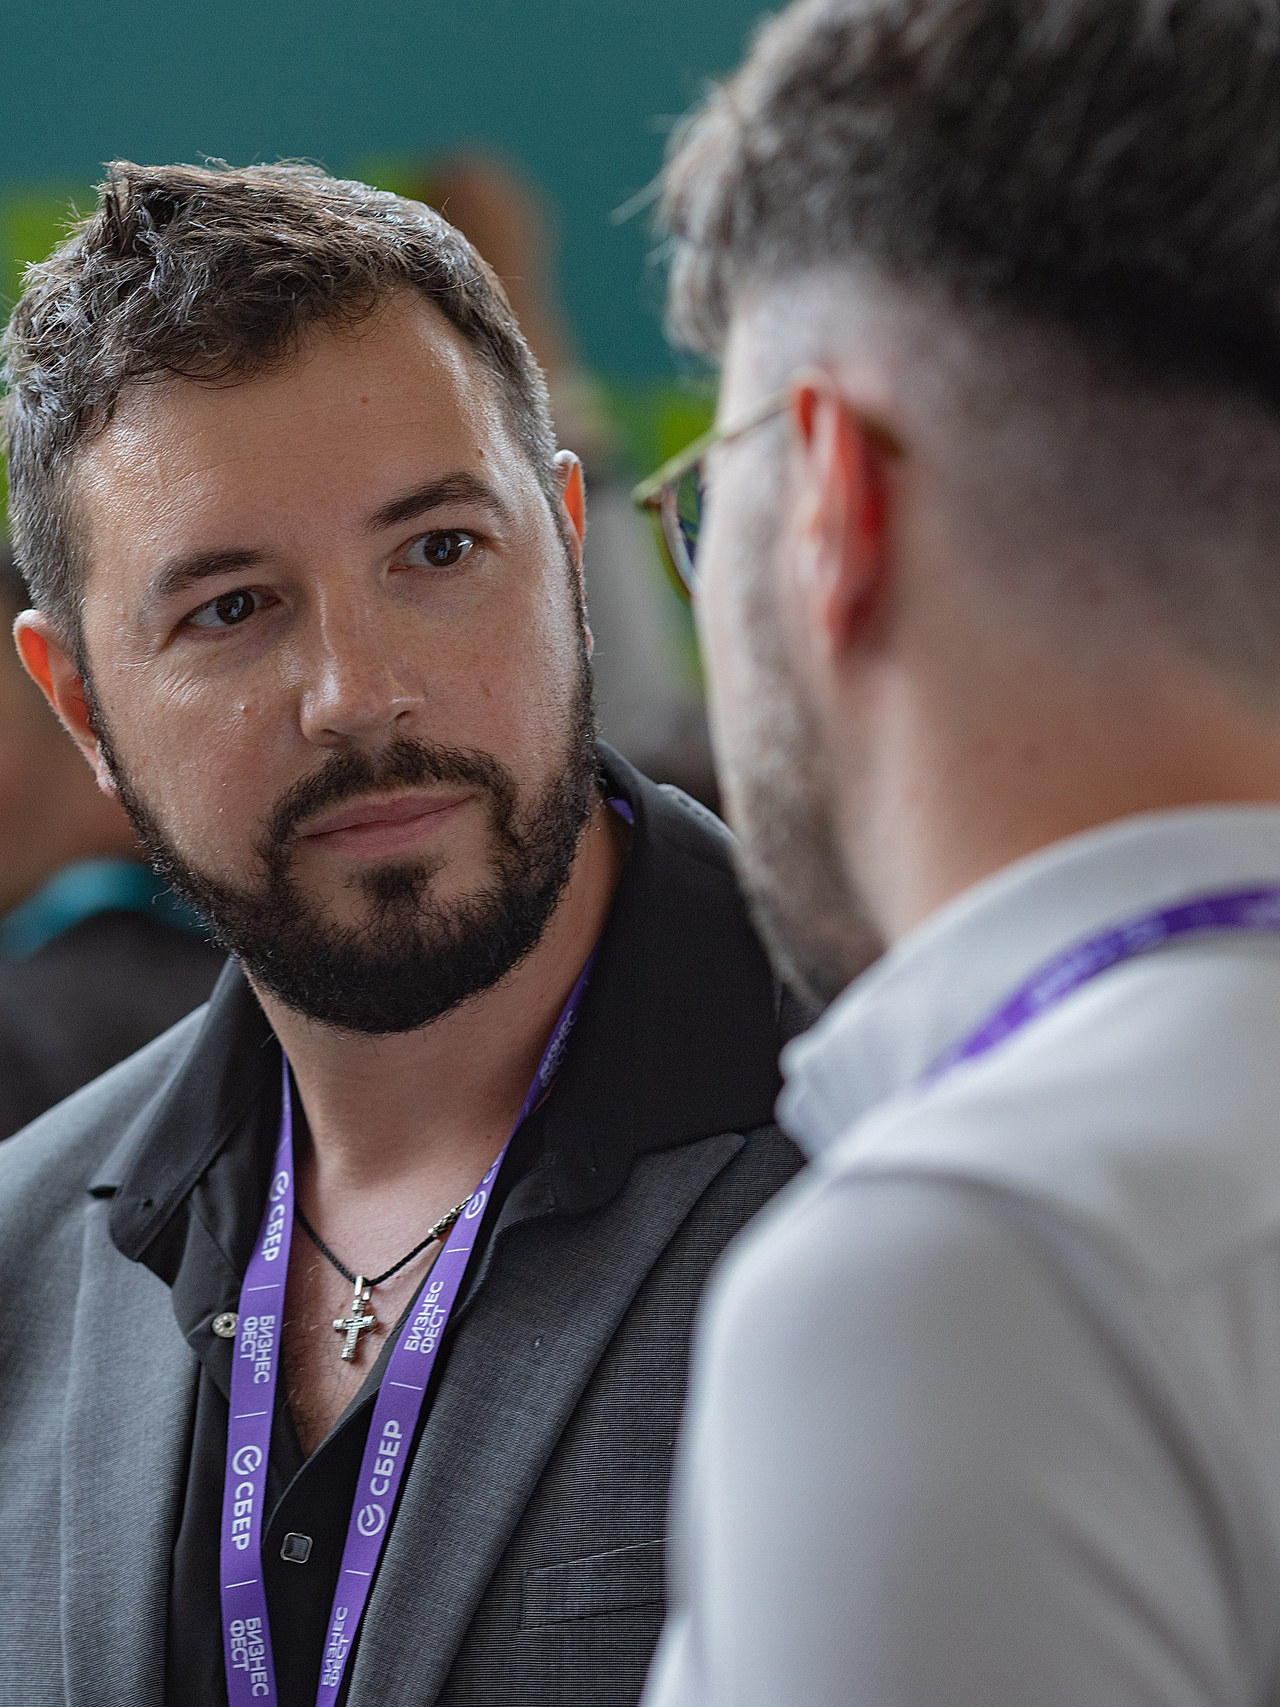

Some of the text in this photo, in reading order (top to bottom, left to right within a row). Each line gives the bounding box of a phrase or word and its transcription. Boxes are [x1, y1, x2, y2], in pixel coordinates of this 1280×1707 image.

[261, 1204, 285, 1262] СБЕР
[240, 1316, 258, 1360] ФЕСТ
[254, 1315, 275, 1384] БИЗНЕС
[404, 1281, 444, 1351] БИЗНЕС
[420, 1305, 446, 1354] ФЕСТ
[370, 1420, 402, 1496] СБЕР
[231, 1481, 254, 1550] СБЕР
[229, 1619, 249, 1671] ФЕСТ
[245, 1617, 269, 1697] БИЗНЕС
